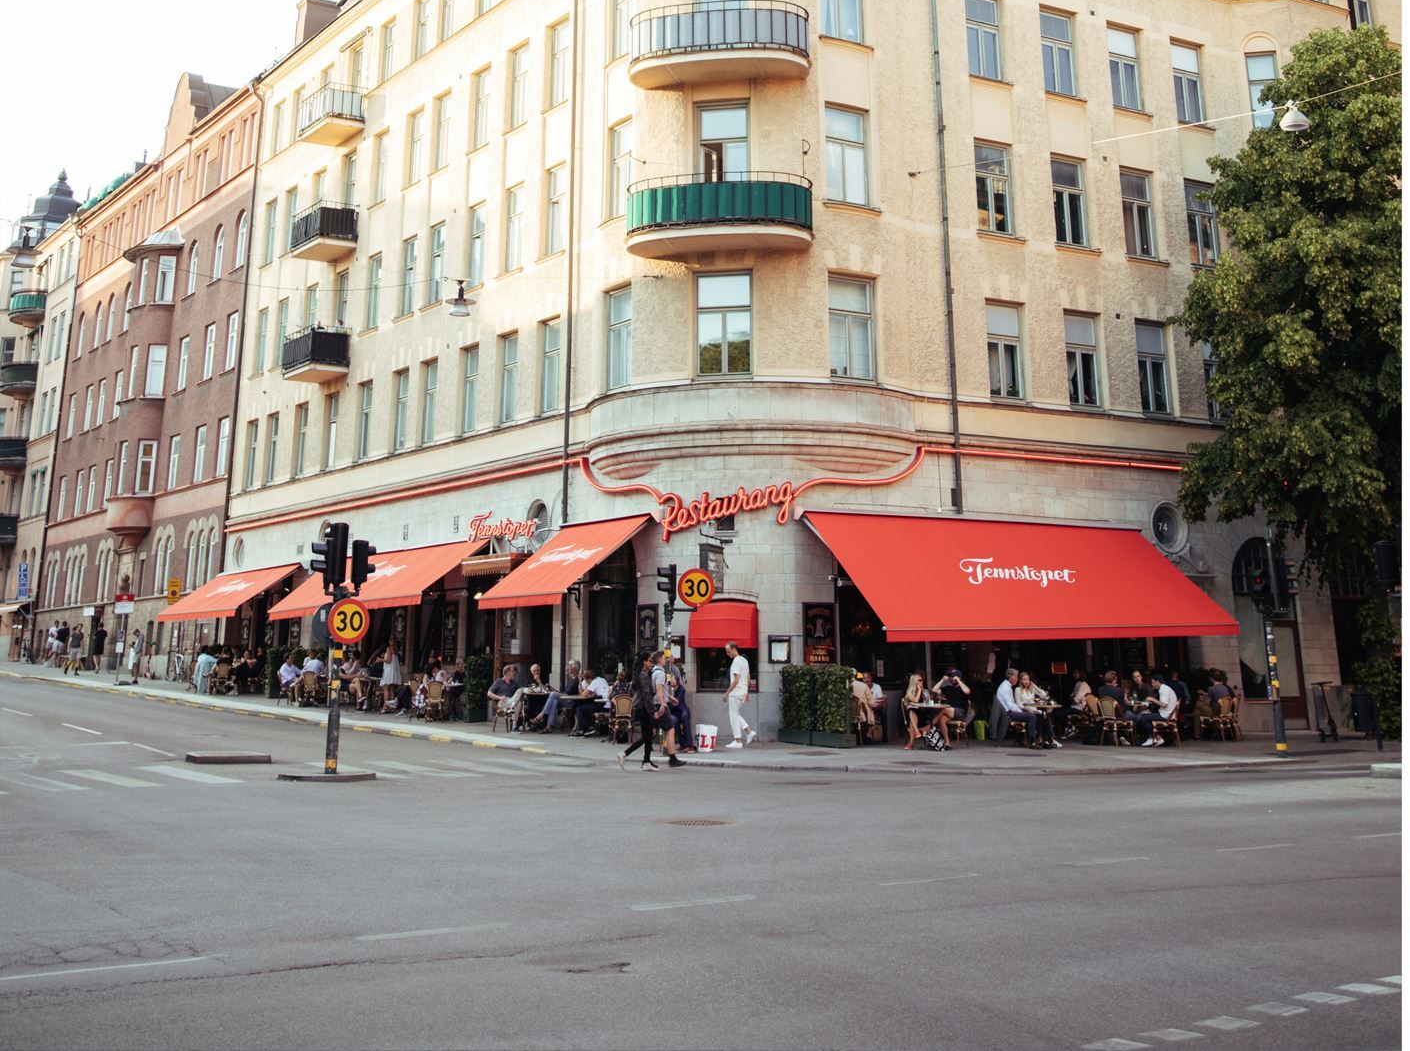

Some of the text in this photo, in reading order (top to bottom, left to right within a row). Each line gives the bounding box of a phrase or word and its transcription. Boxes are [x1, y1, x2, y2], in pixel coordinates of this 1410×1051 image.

[659, 481, 794, 542] Restaurang
[1157, 522, 1168, 532] 74
[959, 557, 1077, 588] Tennstopet
[684, 578, 710, 598] 30
[335, 610, 364, 633] 30
